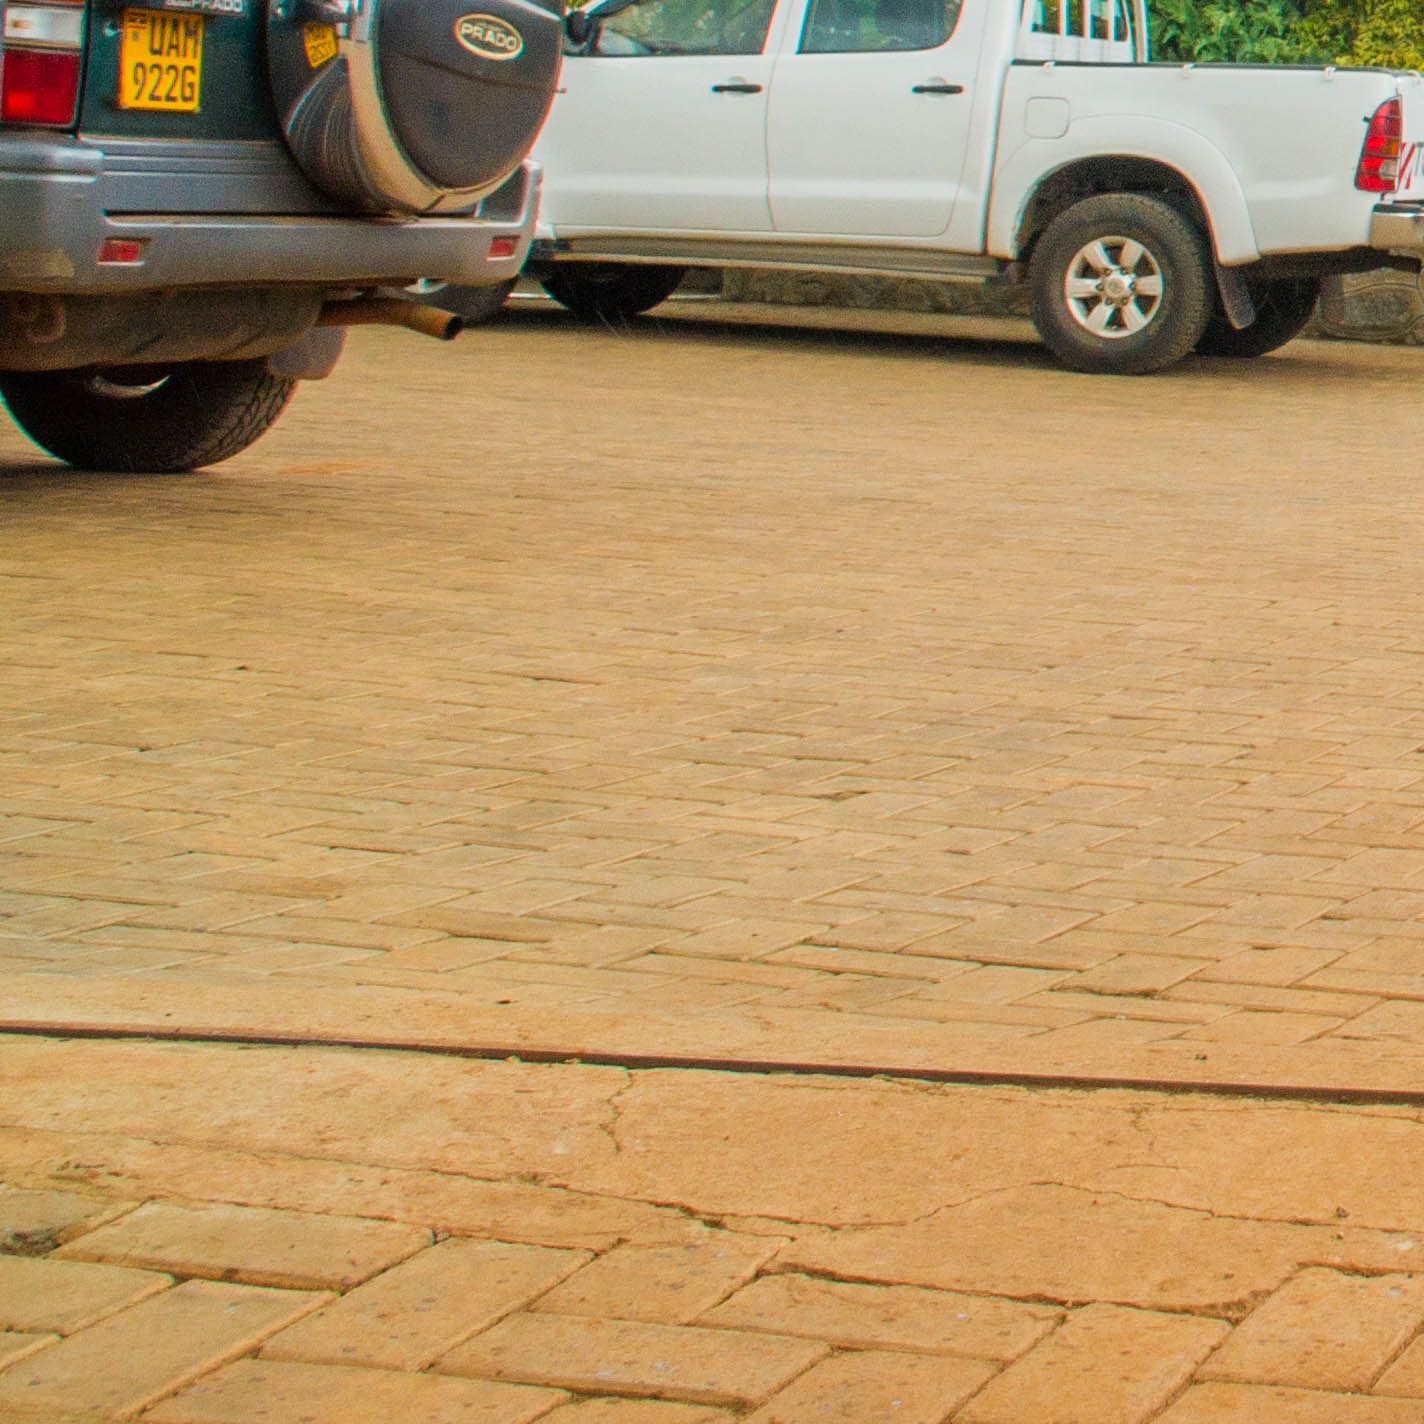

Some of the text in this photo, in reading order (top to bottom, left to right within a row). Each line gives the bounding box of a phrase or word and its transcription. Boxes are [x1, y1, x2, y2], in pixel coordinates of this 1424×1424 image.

[150, 15, 200, 58] UAH
[460, 23, 519, 50] PRADO
[134, 62, 196, 102] 922G
